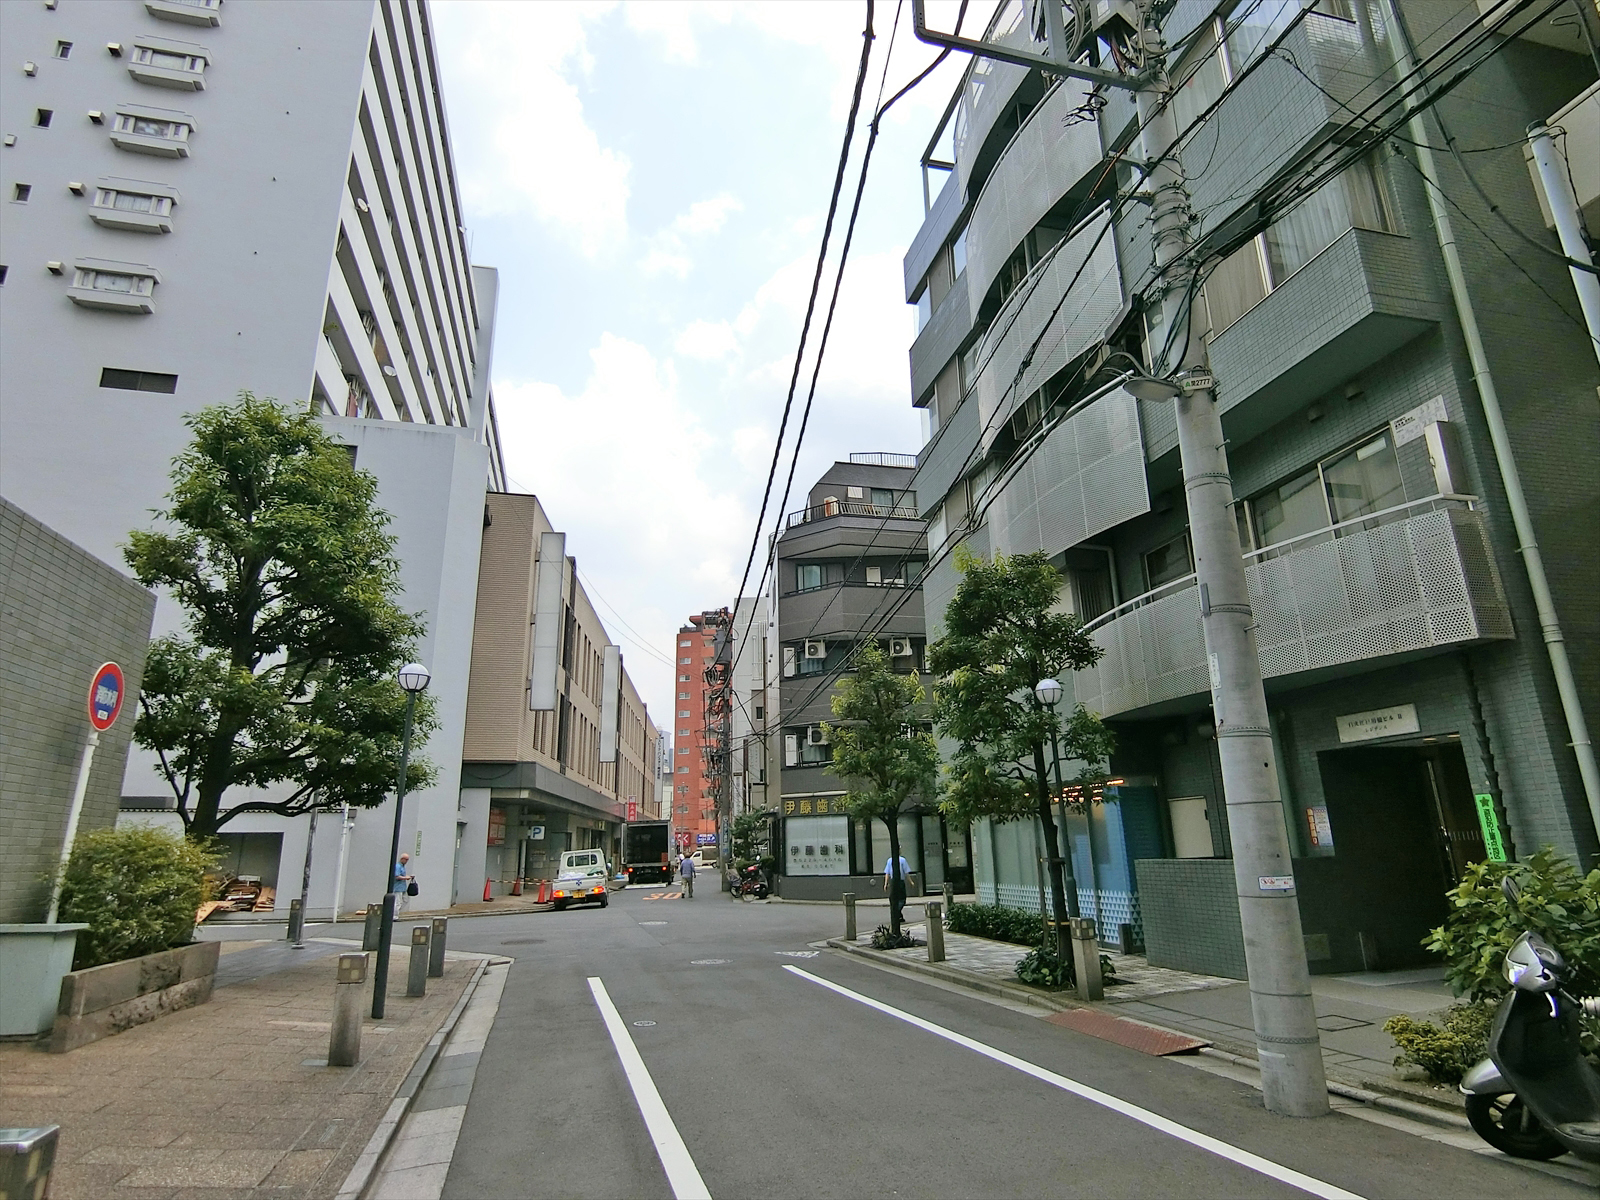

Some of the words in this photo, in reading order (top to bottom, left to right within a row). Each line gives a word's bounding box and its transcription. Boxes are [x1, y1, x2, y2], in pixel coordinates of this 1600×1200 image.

[532, 827, 542, 838] P
[790, 844, 844, 856] 伊藤歯科
